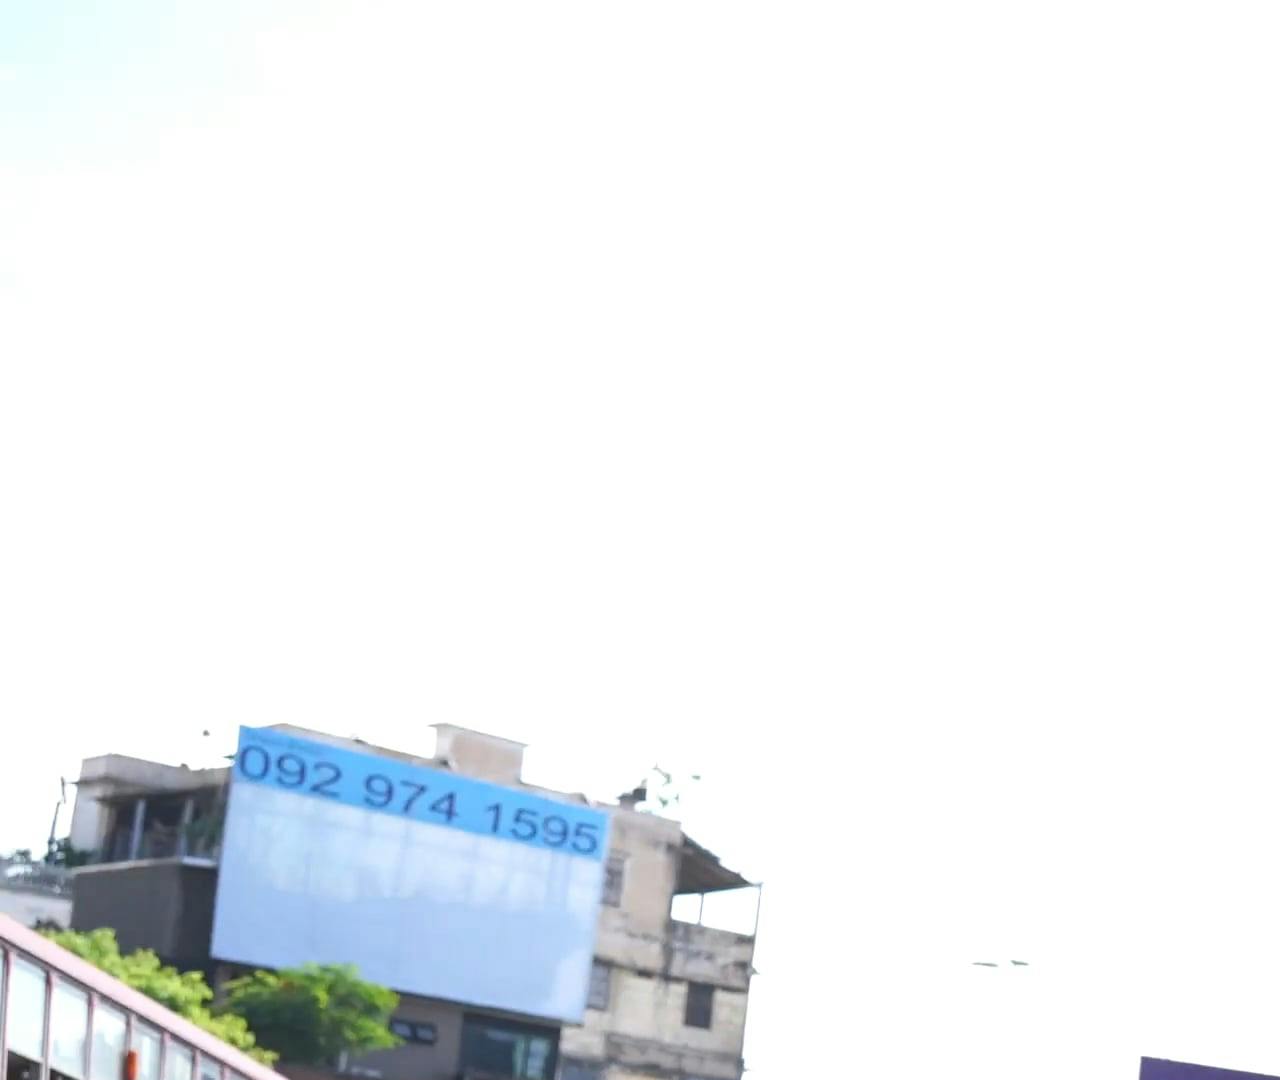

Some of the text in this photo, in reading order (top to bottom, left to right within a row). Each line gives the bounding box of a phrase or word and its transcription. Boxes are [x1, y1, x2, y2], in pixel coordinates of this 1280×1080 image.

[239, 744, 599, 856] 092 974 1595
